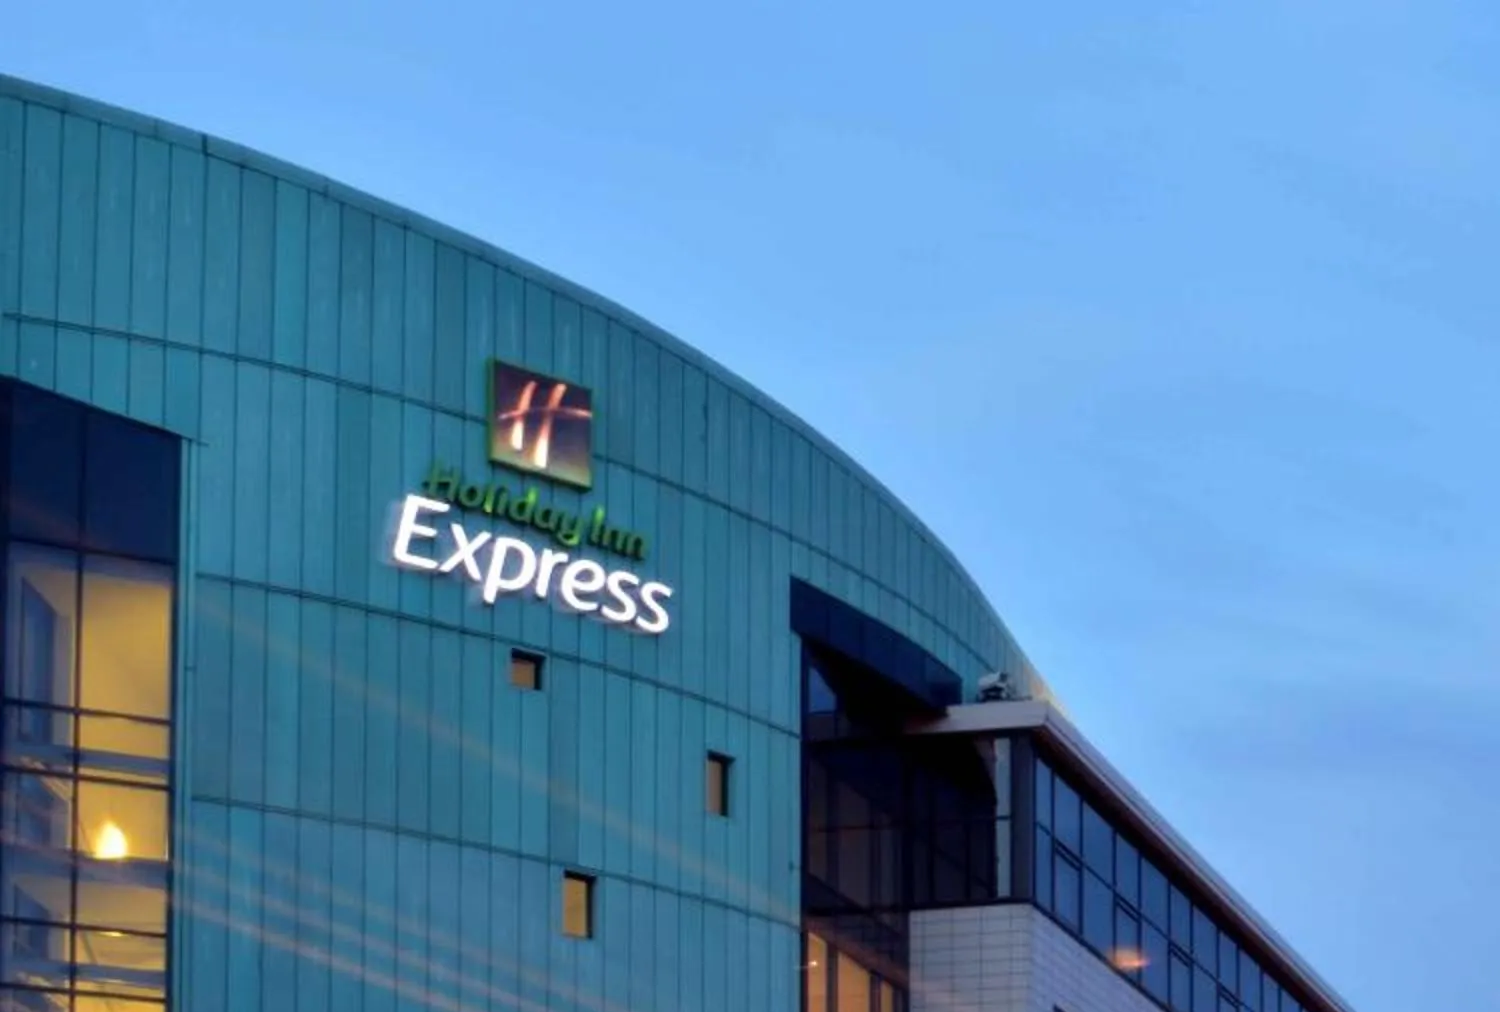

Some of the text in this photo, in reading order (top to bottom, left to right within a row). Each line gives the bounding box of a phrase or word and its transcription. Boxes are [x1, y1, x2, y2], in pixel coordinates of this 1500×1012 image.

[393, 494, 673, 632] Express
[422, 460, 645, 560] Holiday Inn
